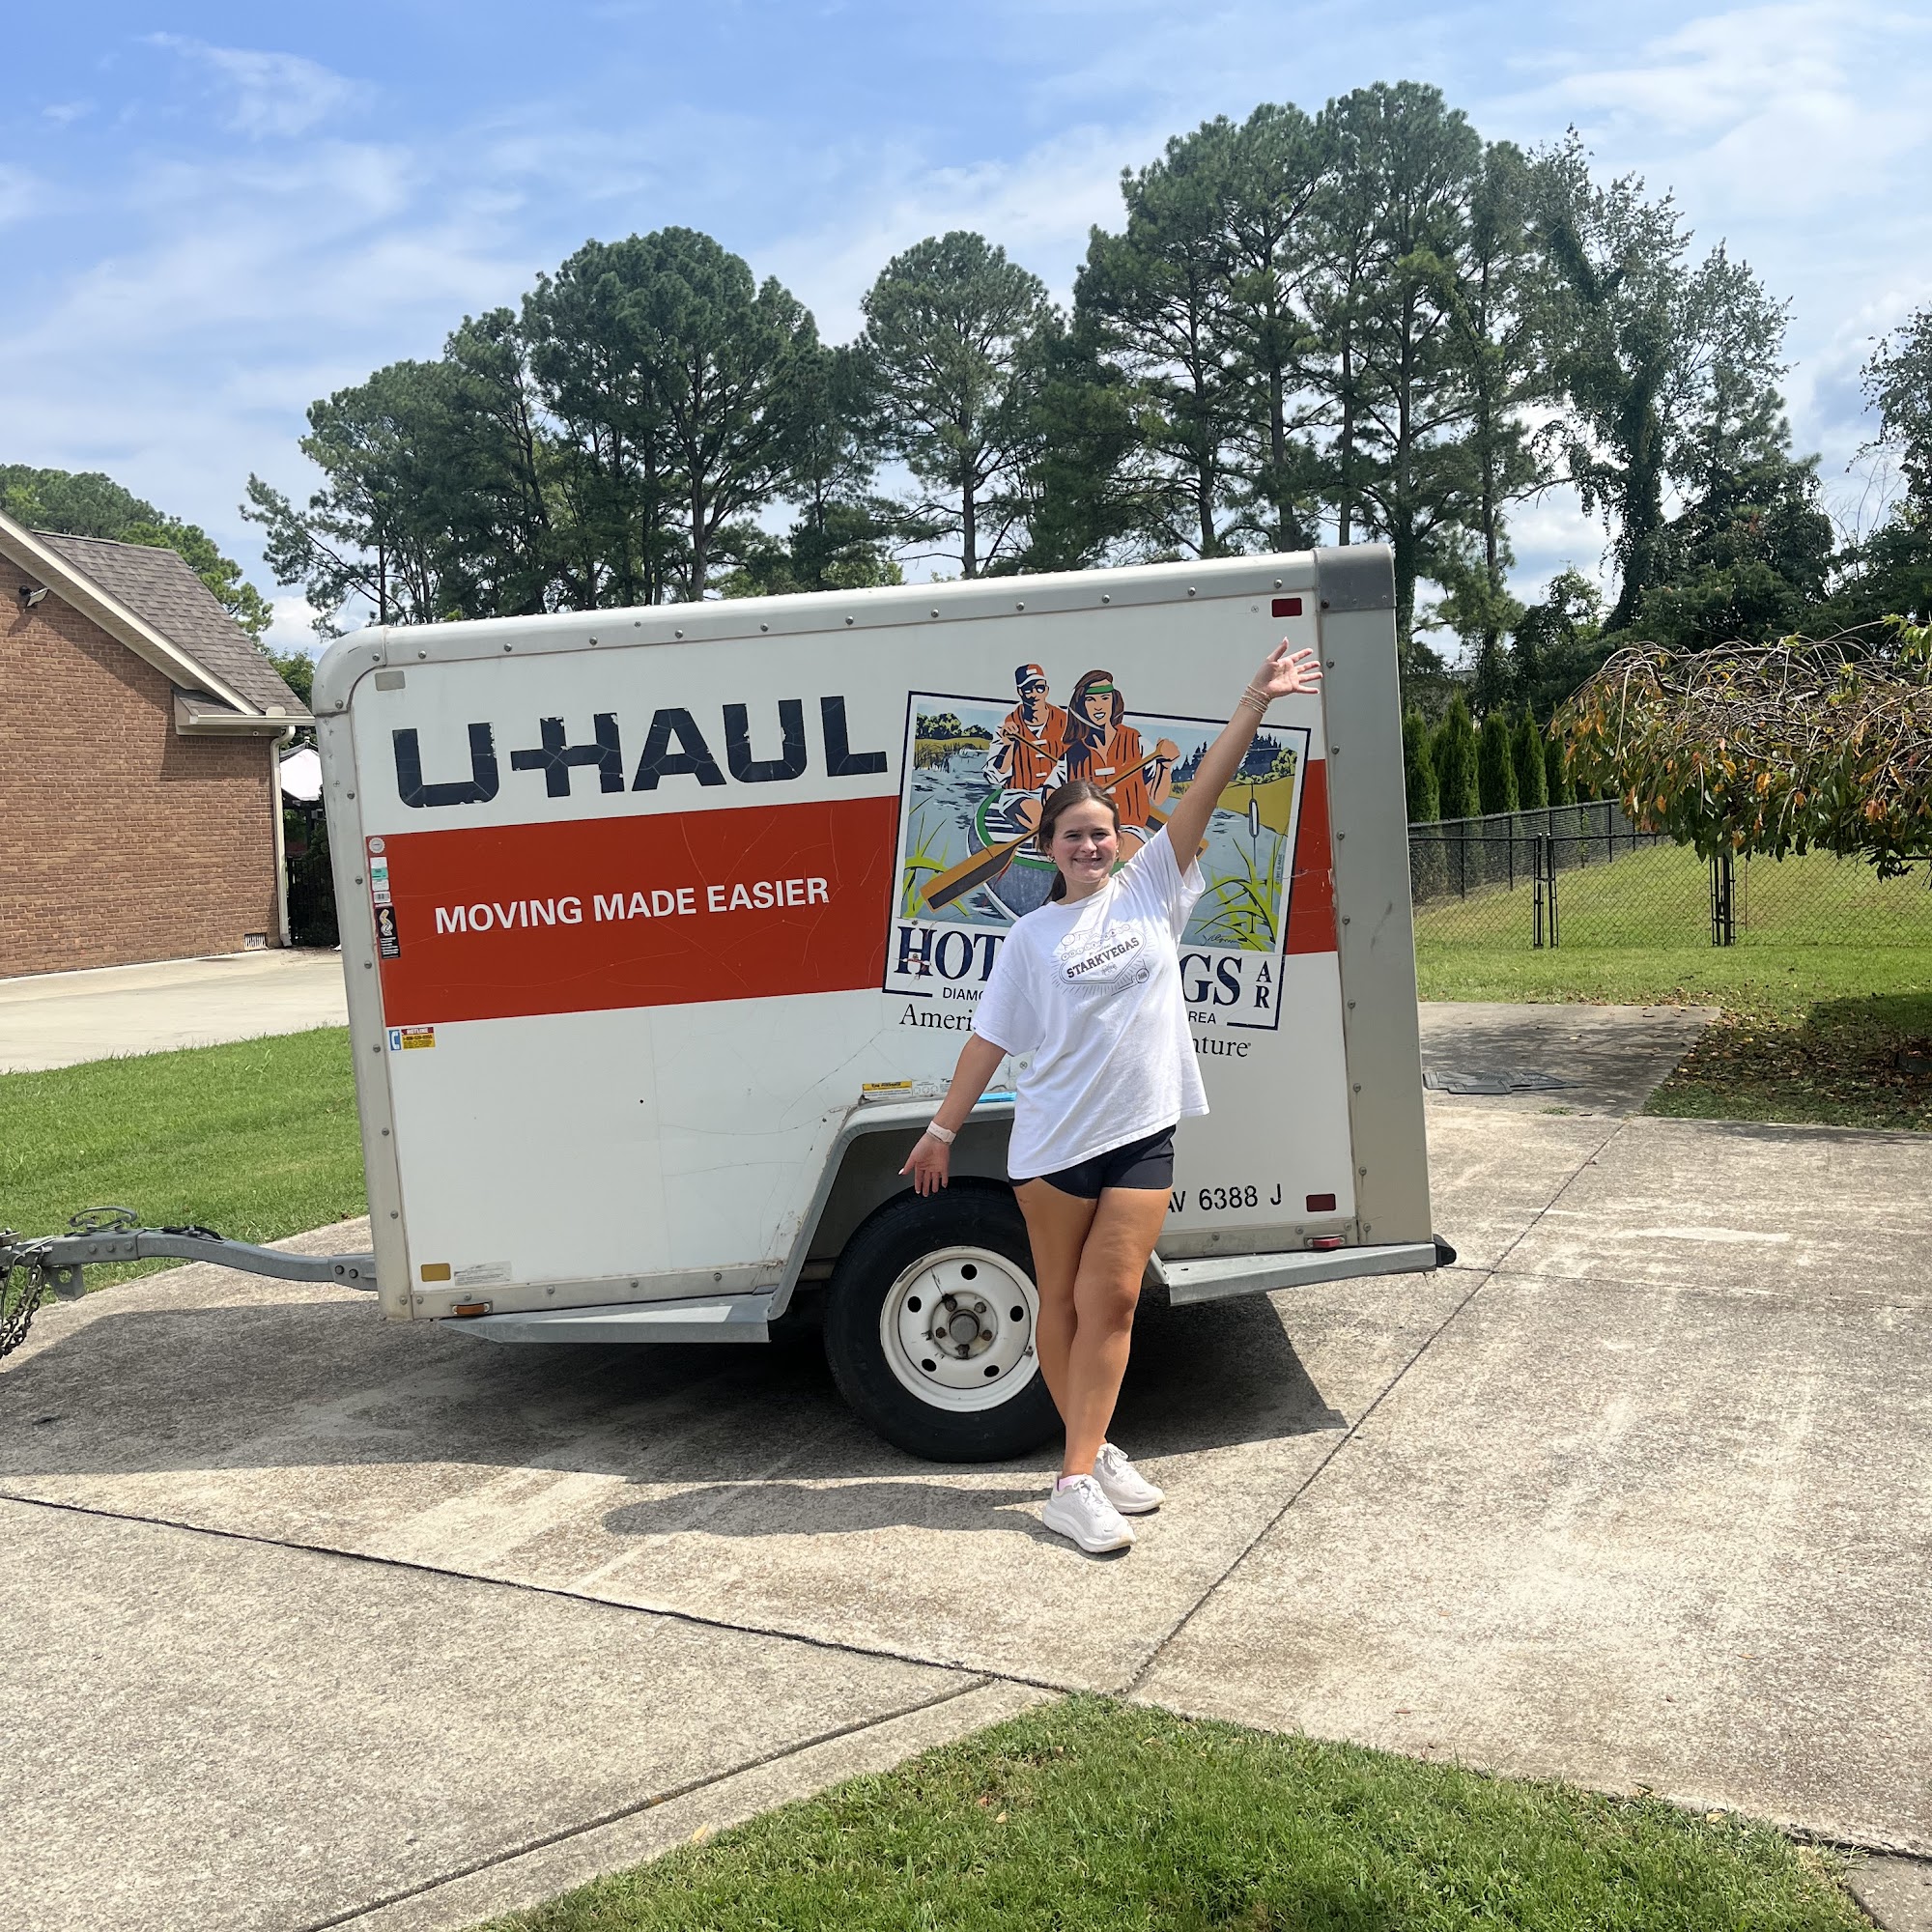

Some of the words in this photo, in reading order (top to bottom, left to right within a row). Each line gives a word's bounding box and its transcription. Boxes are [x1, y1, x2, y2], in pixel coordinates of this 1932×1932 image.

[392, 696, 888, 809] U-HAUL
[435, 895, 583, 934] MOVING
[593, 887, 697, 923] MADE
[706, 877, 830, 913] EASIER
[894, 925, 1006, 982] HOT
[1065, 937, 1140, 979] STARKVEGAS
[898, 1003, 977, 1032] Ameri
[1188, 1010, 1216, 1025] REA
[1199, 1184, 1259, 1211] 6388
[1269, 1182, 1282, 1206] J
